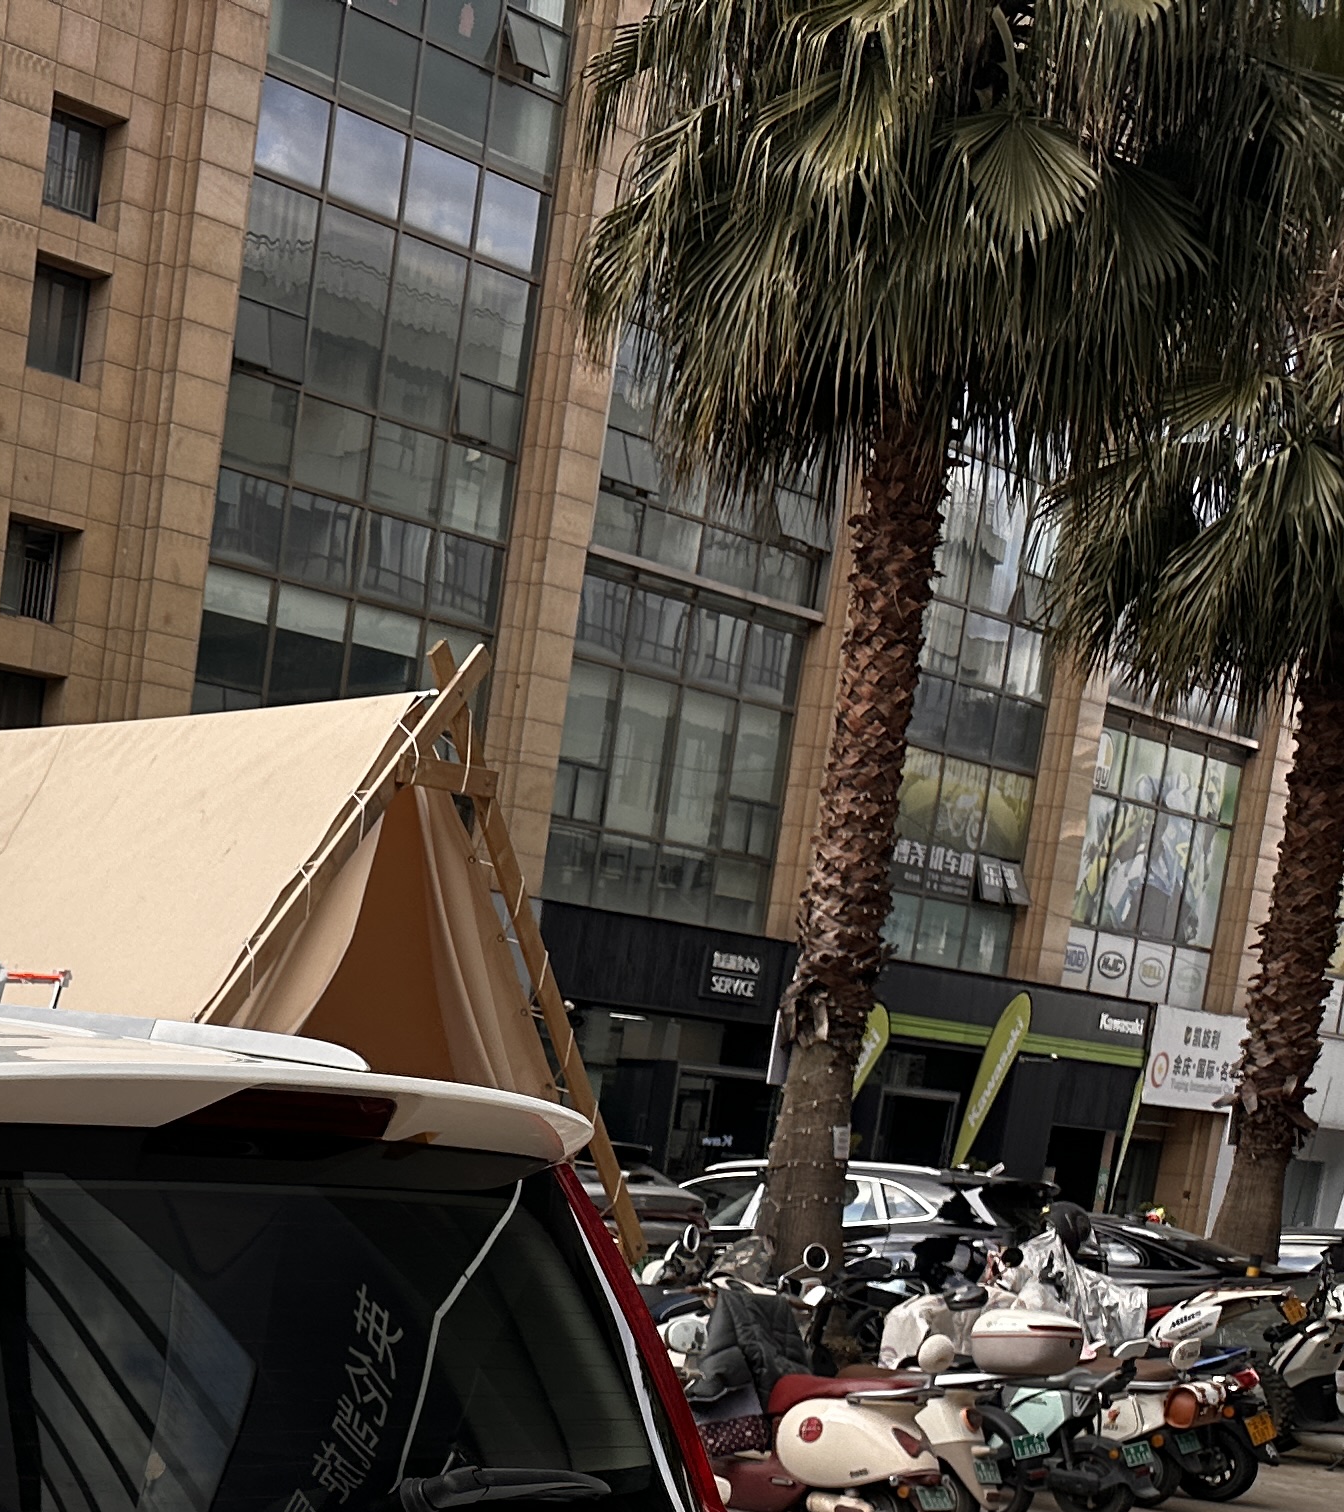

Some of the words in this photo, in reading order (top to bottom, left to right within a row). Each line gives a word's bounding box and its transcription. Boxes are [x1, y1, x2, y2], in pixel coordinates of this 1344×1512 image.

[710, 975, 756, 998] SERVICE
[1099, 1012, 1145, 1036] Kawasaki
[967, 1014, 1024, 1128] Kawasaki
